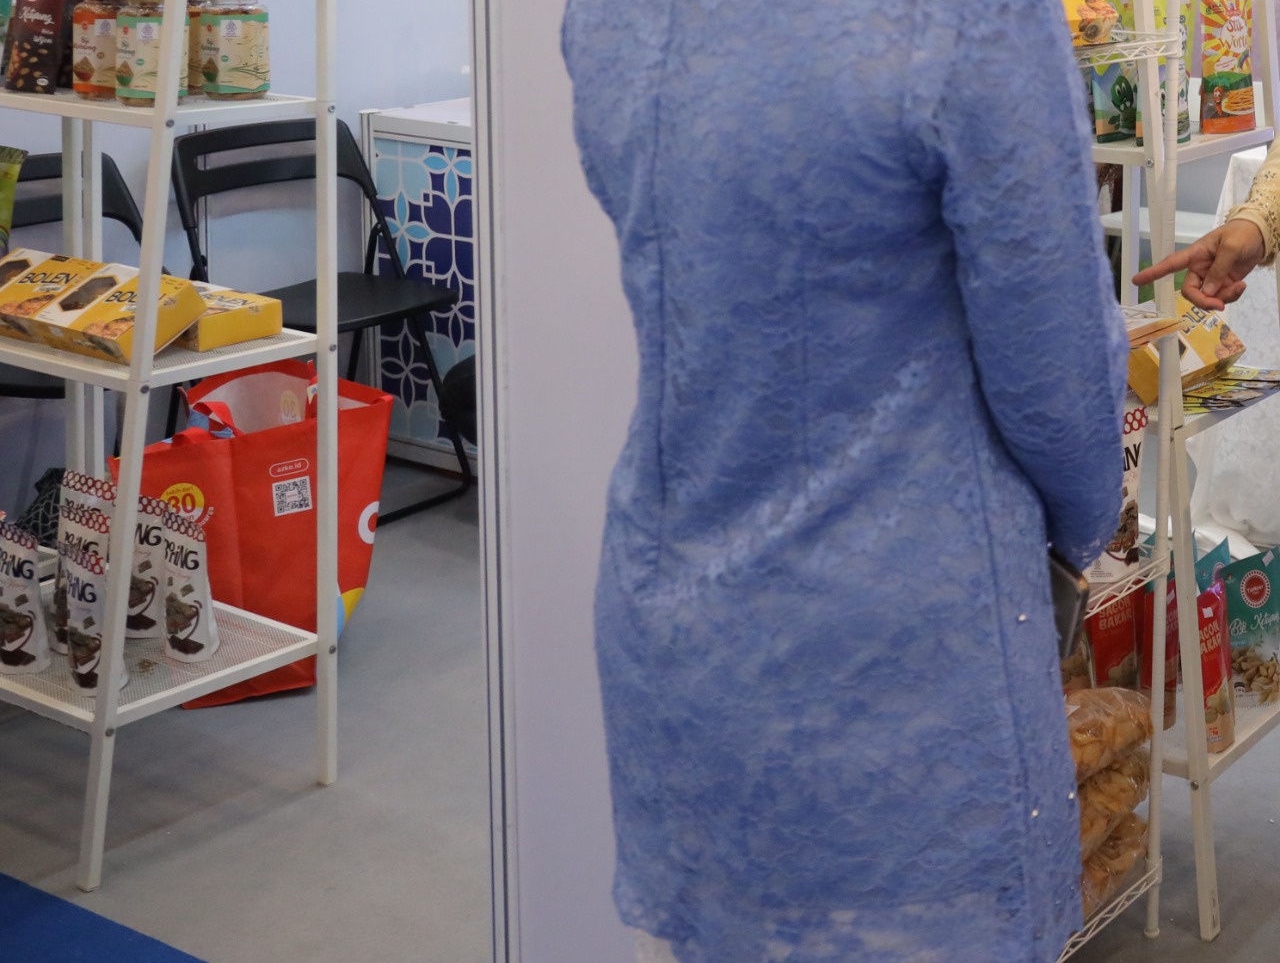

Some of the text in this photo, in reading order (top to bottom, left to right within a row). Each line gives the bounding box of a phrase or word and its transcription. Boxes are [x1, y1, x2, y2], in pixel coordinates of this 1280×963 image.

[18, 272, 78, 284] BOLEN
[276, 462, 302, 474] azko.id
[168, 492, 196, 515] 30
